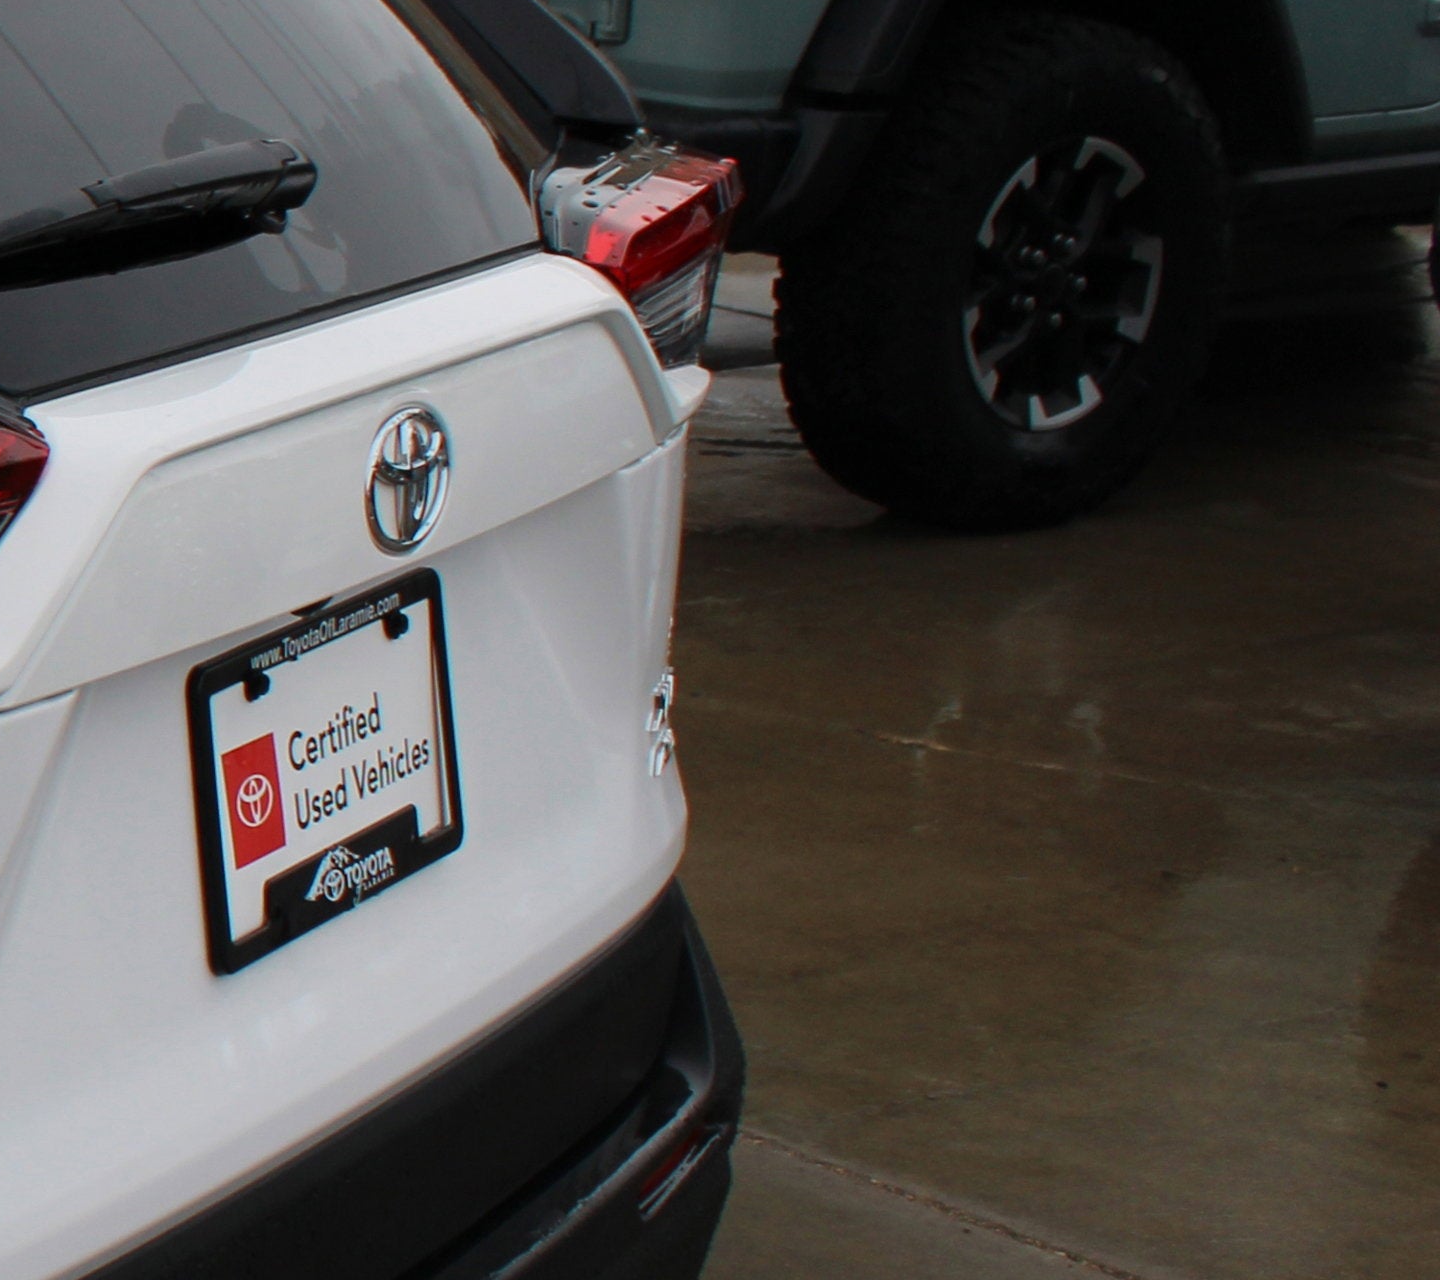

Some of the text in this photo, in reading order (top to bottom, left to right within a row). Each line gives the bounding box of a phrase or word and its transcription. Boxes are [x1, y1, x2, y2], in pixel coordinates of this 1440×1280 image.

[250, 592, 400, 670] www.ToyotaOfLaramie.com
[288, 692, 381, 770] Certified
[294, 737, 430, 830] Used Vehicles
[344, 846, 394, 889] TOYOTA
